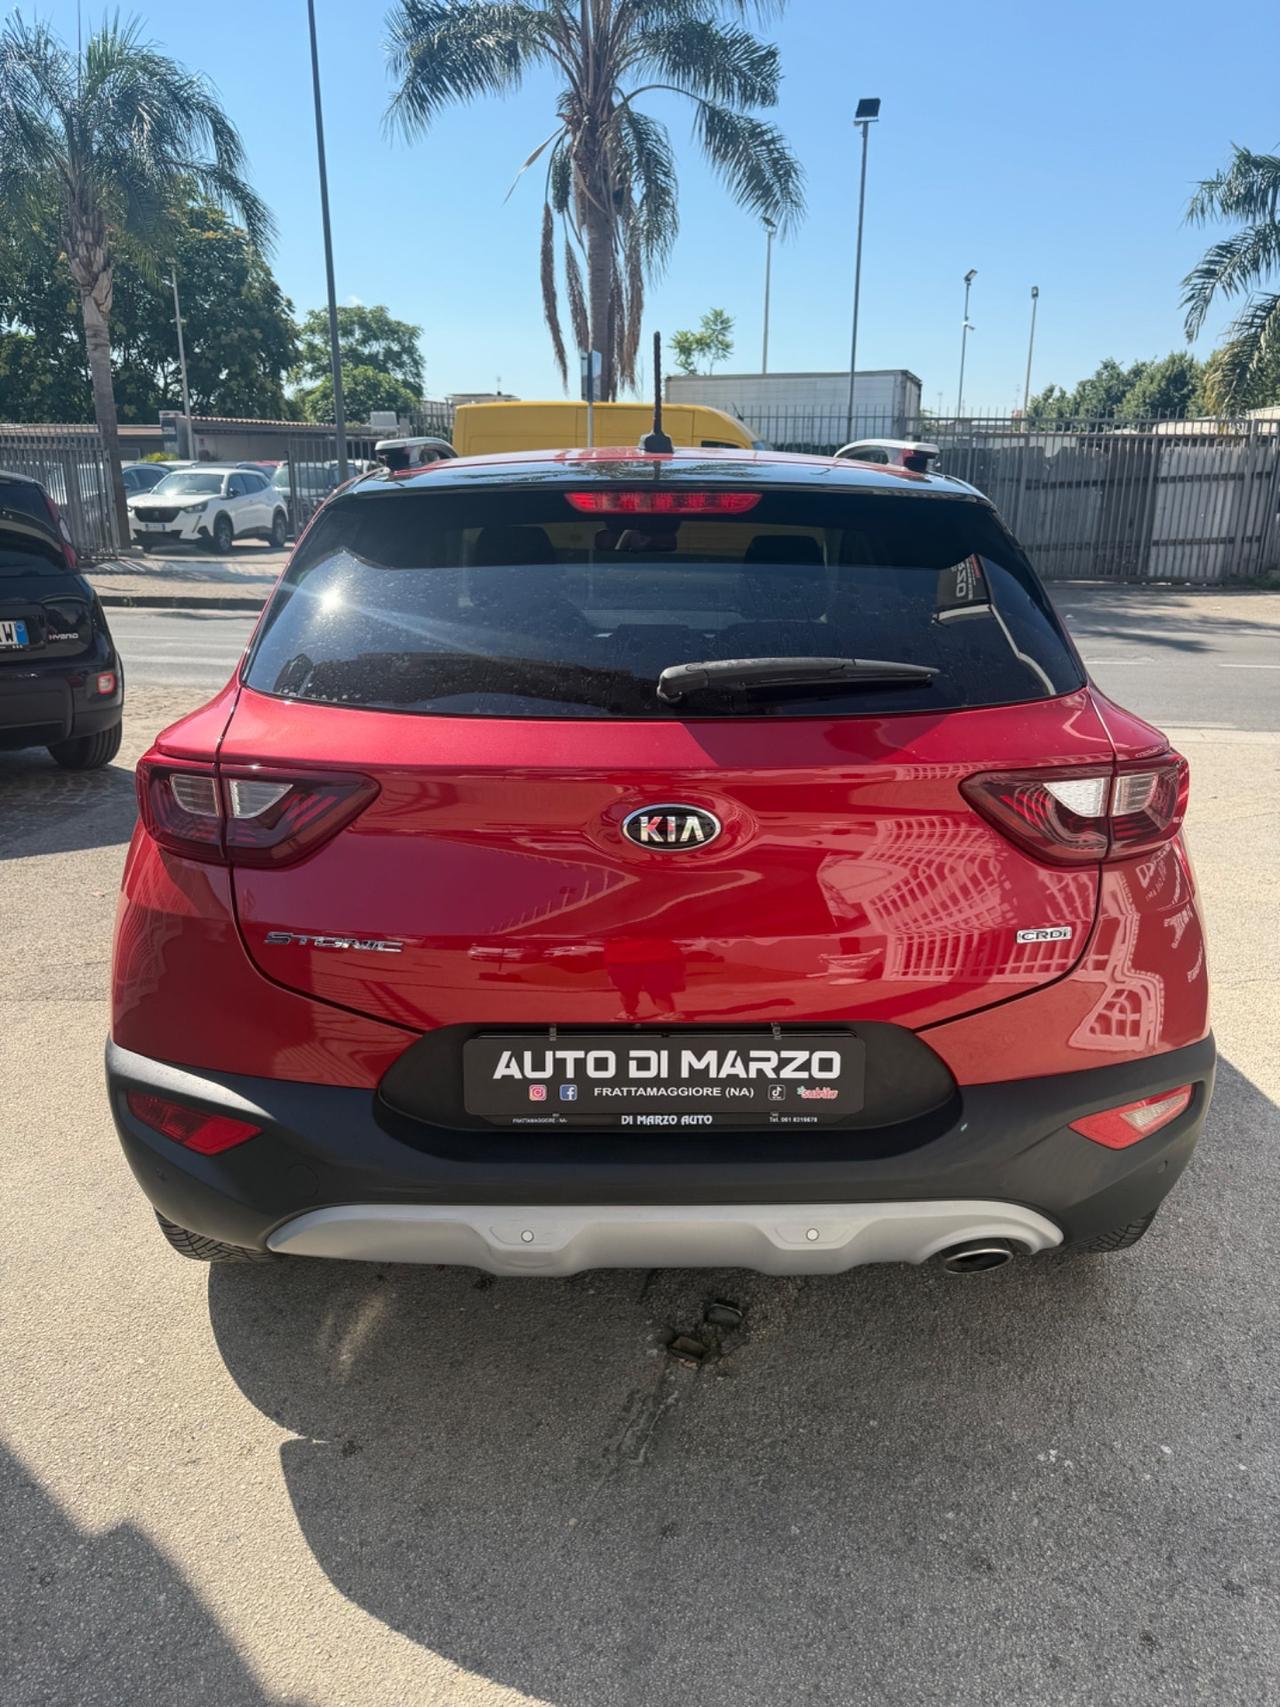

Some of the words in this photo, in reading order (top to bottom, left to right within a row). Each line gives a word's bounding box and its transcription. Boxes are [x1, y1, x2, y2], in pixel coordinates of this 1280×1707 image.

[639, 816, 704, 842] KIA
[264, 931, 404, 952] STONIC
[1021, 927, 1068, 941] CRDi
[493, 1050, 616, 1079] AUTO
[628, 1050, 668, 1079] DI
[681, 1050, 841, 1079] MARZO
[594, 1087, 722, 1097] FRATTAMAGGIORE
[725, 1086, 754, 1098] (NA)
[621, 1115, 633, 1125] DI
[637, 1115, 678, 1126] MARZO
[681, 1115, 713, 1125] AUTO
